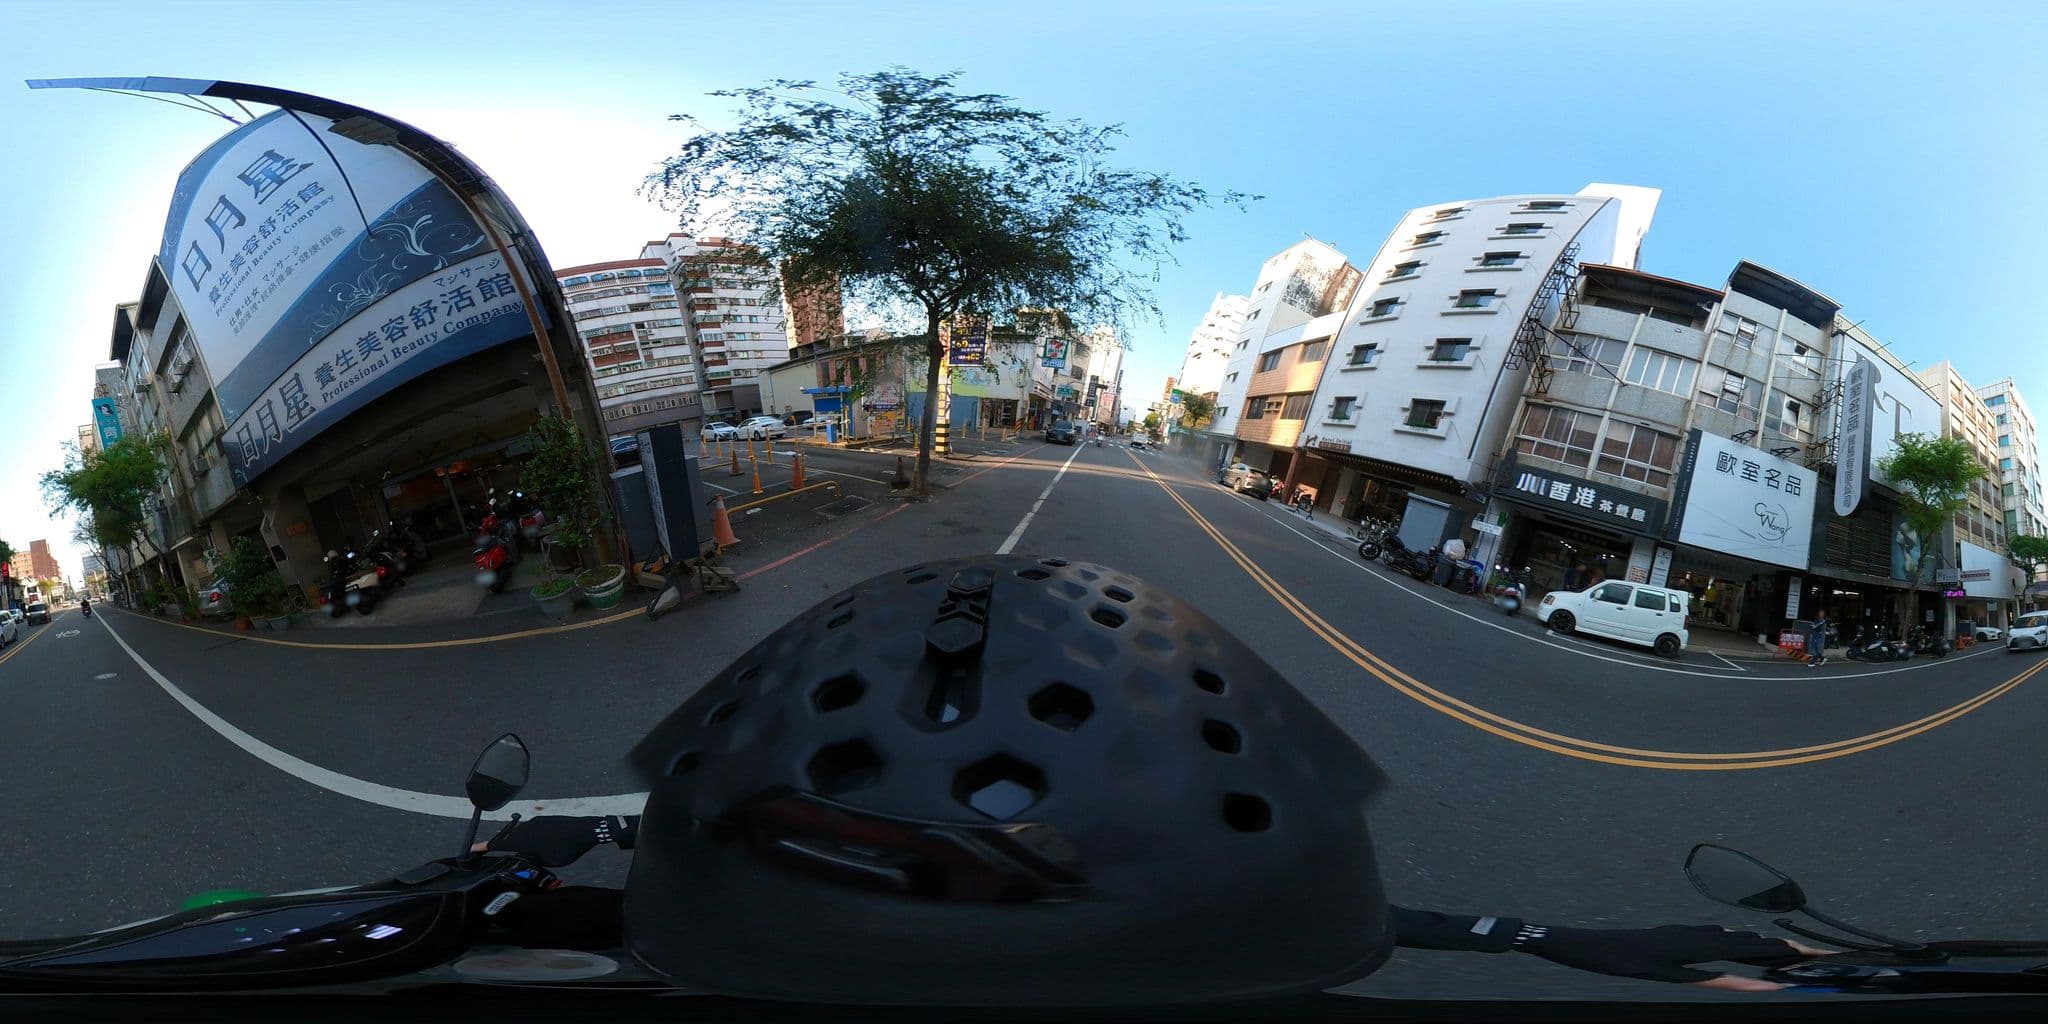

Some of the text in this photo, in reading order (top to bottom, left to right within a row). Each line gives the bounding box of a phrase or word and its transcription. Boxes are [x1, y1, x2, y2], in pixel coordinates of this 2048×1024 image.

[182, 149, 314, 293] 日月星
[208, 181, 325, 307] 養生美容舒活館
[215, 194, 336, 317] Professional Beauty Company
[432, 256, 501, 288] マッサージ
[235, 272, 517, 468] 日月星 養生美容舒活館
[321, 300, 524, 403] Professional Beauty Company
[1716, 451, 1801, 497] 歐室名品
